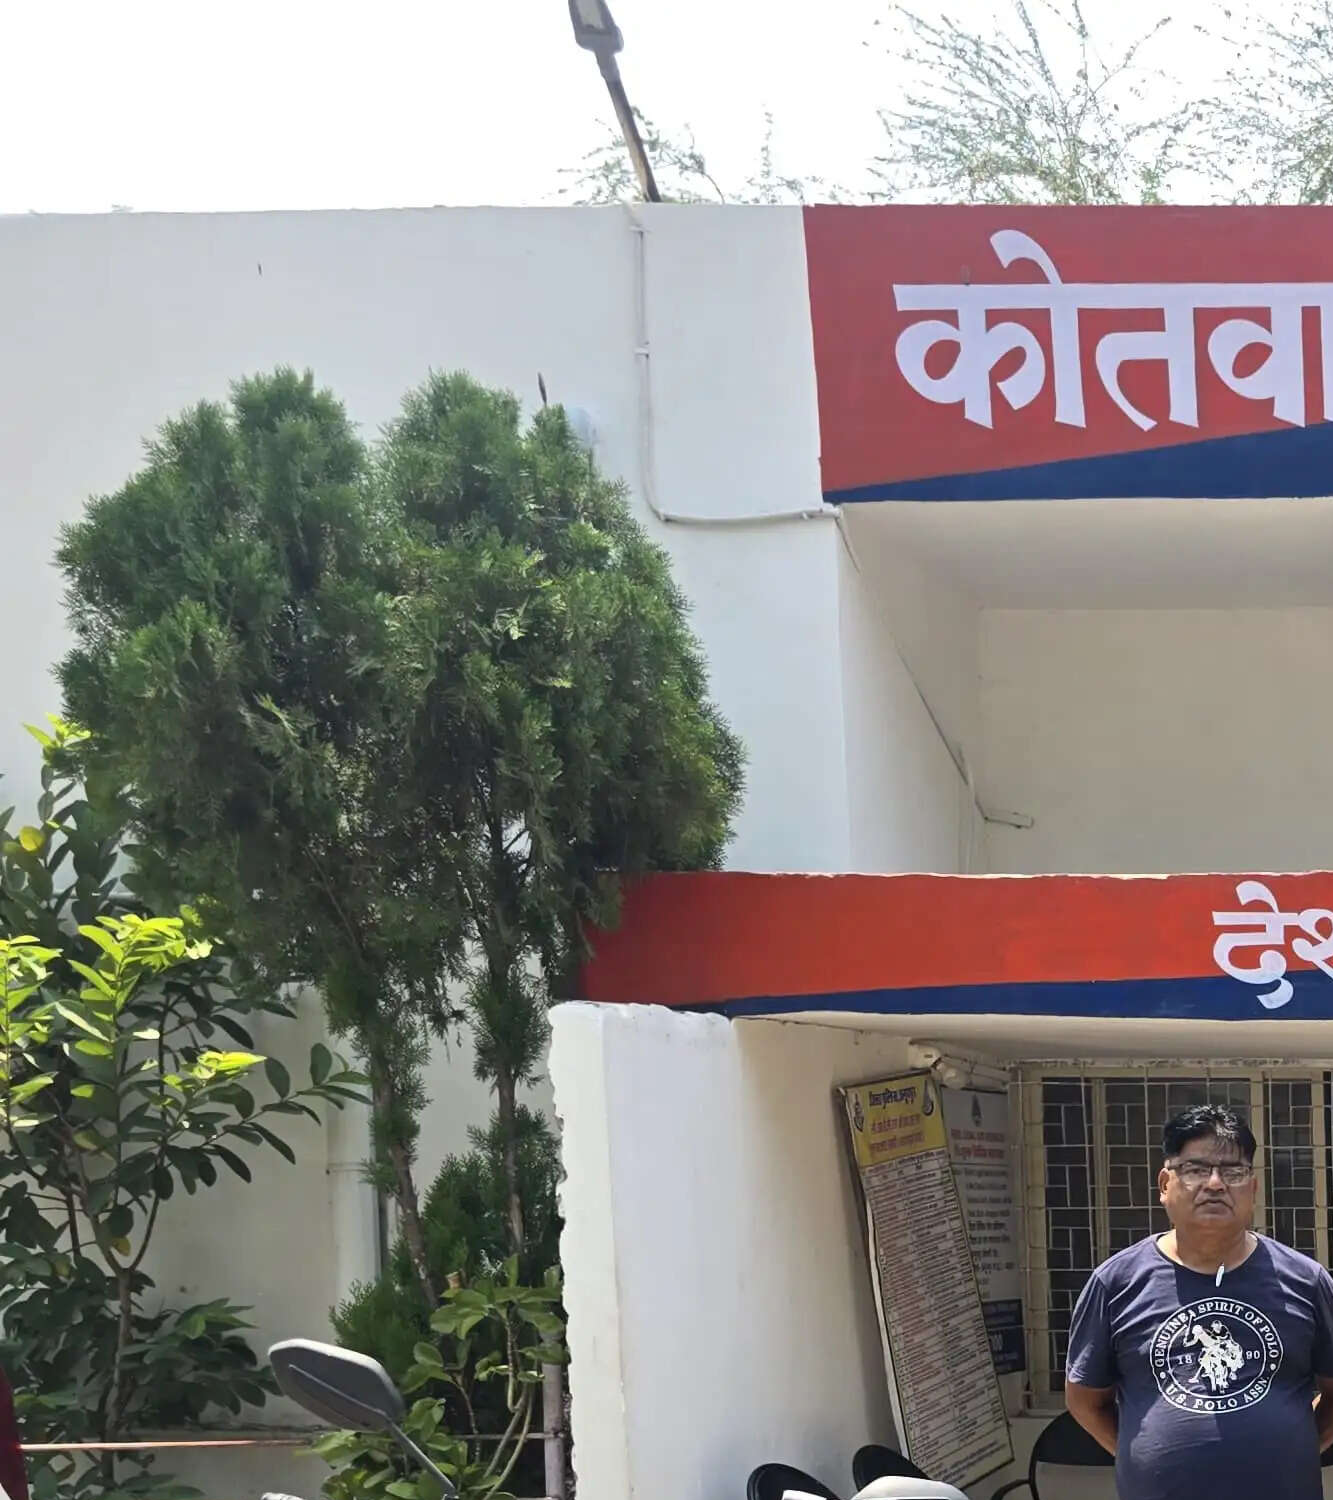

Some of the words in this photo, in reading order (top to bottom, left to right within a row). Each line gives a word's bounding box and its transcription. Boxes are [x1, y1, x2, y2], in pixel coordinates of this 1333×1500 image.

[1197, 1301, 1244, 1316] SPIRIT
[1244, 1311, 1264, 1329] OF
[1258, 1325, 1280, 1359] POLO
[1193, 1398, 1238, 1411] POLO
